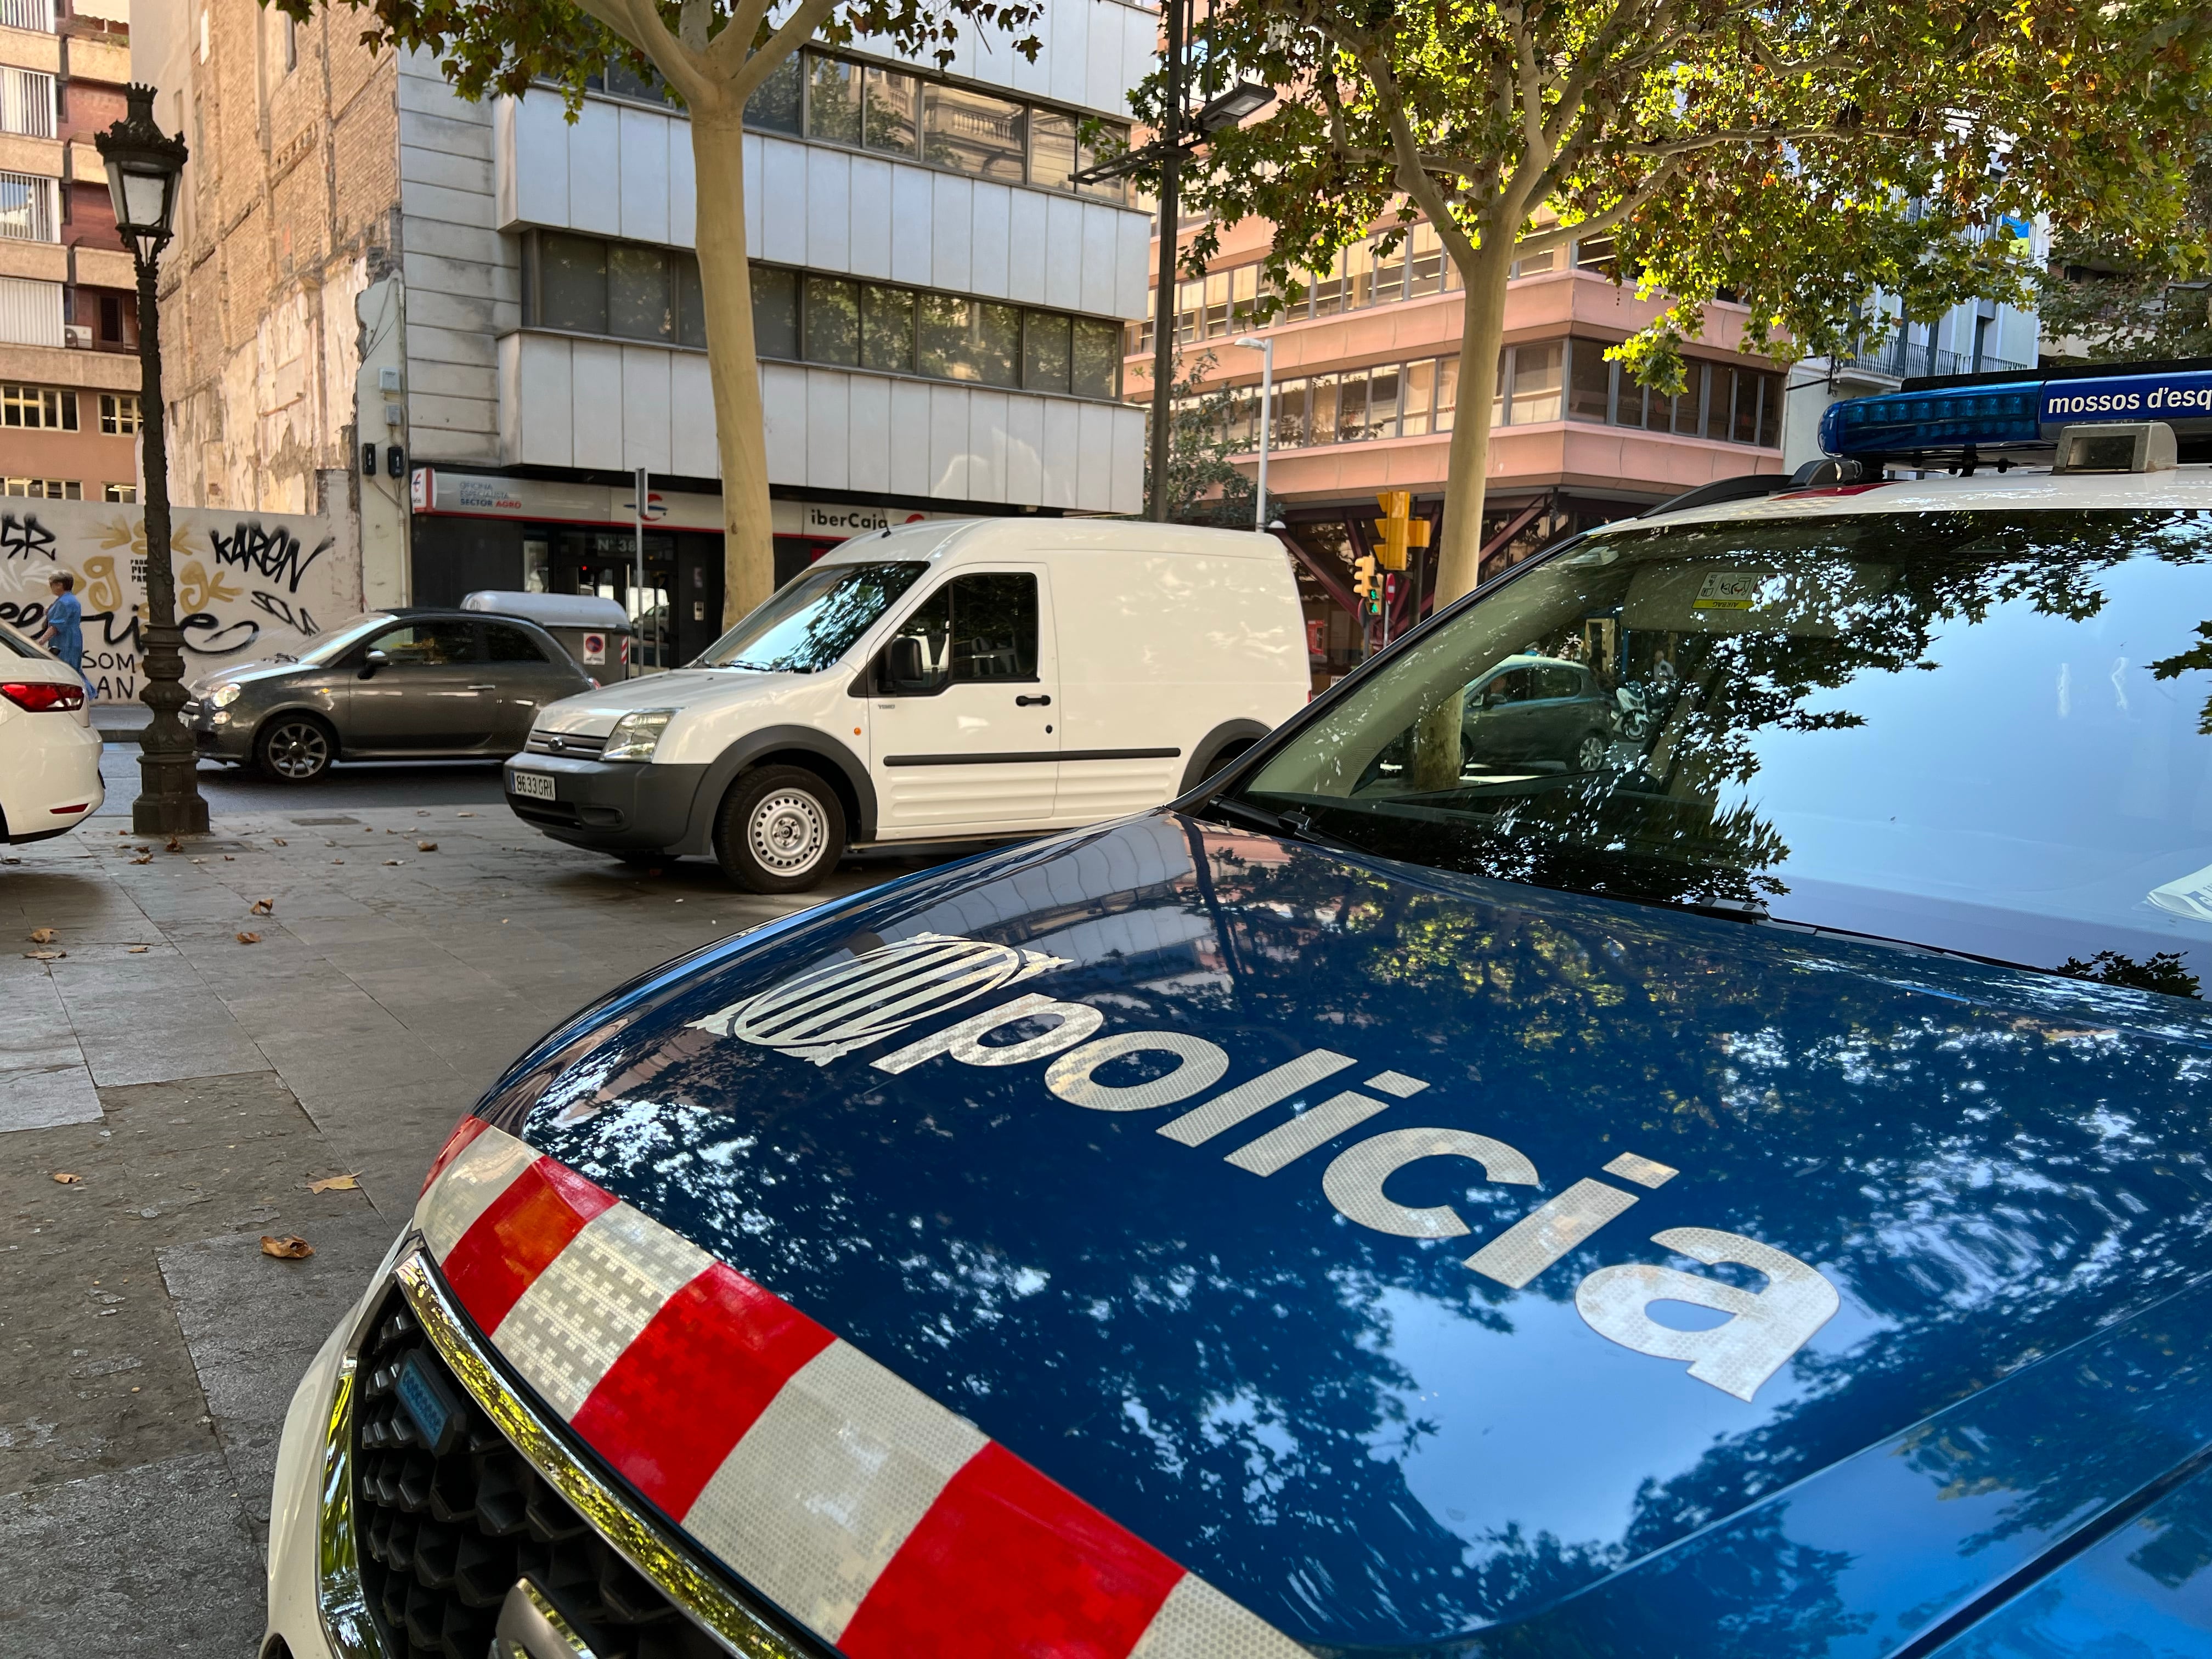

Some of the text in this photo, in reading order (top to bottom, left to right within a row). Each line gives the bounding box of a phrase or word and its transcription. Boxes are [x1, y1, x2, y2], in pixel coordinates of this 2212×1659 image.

[2049, 387, 2212, 414] mossos d'esq
[460, 498, 522, 509] SECTOR AGRO
[811, 509, 888, 531] iberCaja
[618, 539, 636, 552] 38
[516, 775, 554, 798] 8633 GRX
[868, 993, 1841, 1404] policia
